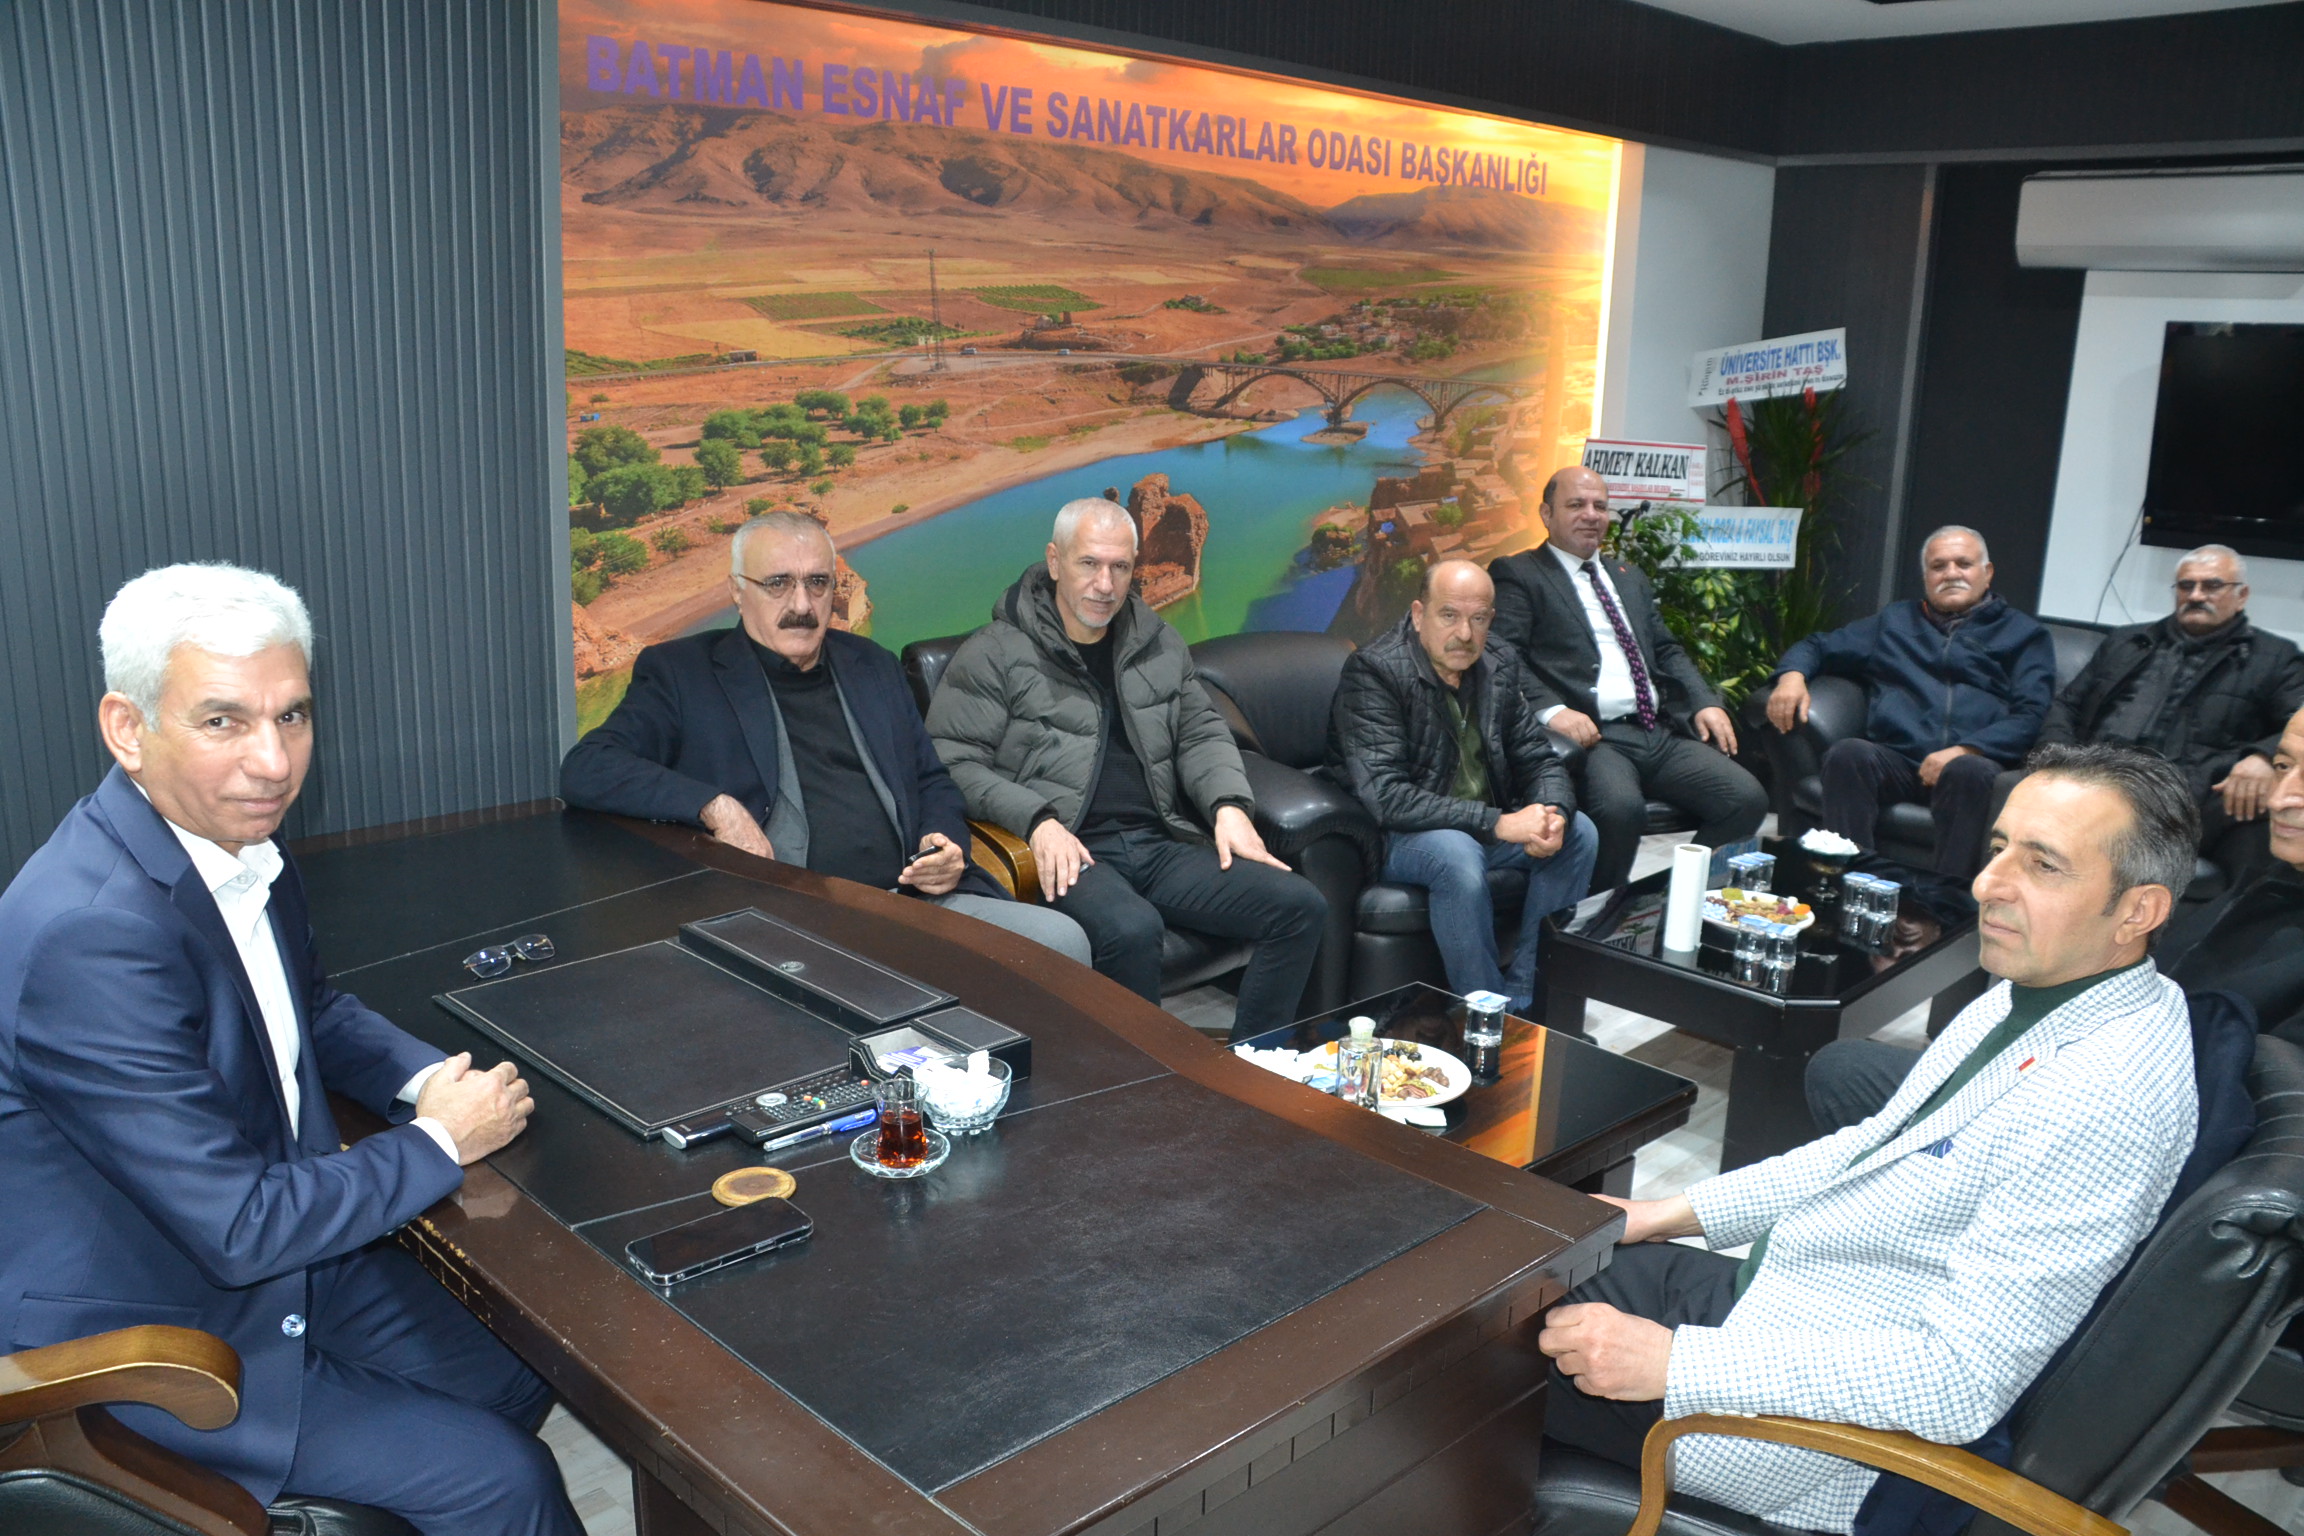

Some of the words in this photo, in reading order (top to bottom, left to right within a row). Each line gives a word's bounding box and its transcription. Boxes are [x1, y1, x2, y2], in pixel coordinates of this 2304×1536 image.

[586, 34, 804, 110] BATMAN
[822, 63, 967, 126] ESNAF
[980, 82, 1033, 134] VE
[1046, 91, 1298, 165] SANATKARLAR
[1307, 129, 1391, 177] ODASI
[1401, 142, 1547, 195] BAŞKANLIĞI
[1720, 345, 1783, 376] ÜNİVERSİTE
[1793, 364, 1825, 377] TAŞ
[1584, 449, 1634, 477] AHMET
[1634, 452, 1689, 480] KALKAN
[1768, 553, 1791, 562] OLSUN
